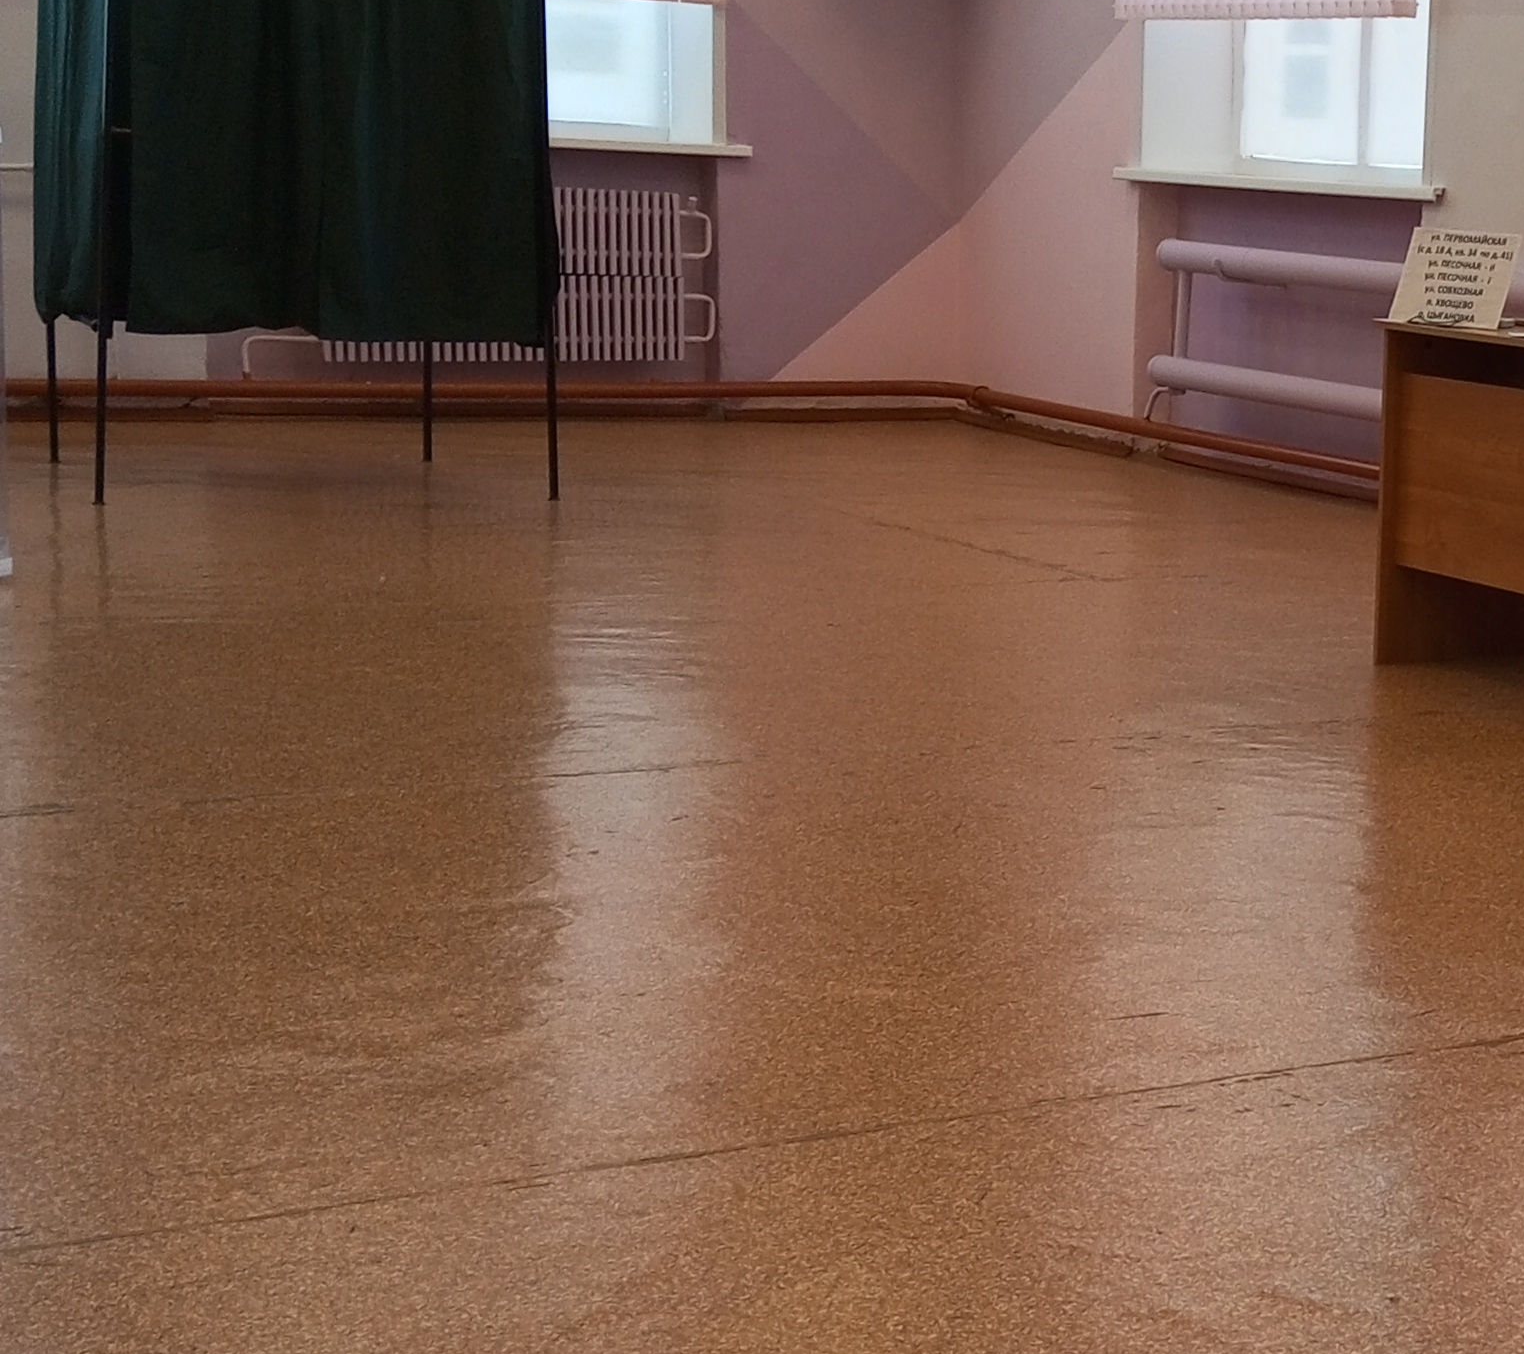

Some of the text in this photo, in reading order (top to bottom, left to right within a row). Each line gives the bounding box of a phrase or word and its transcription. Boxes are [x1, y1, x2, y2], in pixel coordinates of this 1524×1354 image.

[1440, 259, 1482, 271] ПЕСОЧНАЯ
[1437, 272, 1479, 284] ПЕСОЧНАЯ
[1437, 285, 1484, 297] СОВХОЗНАЯ
